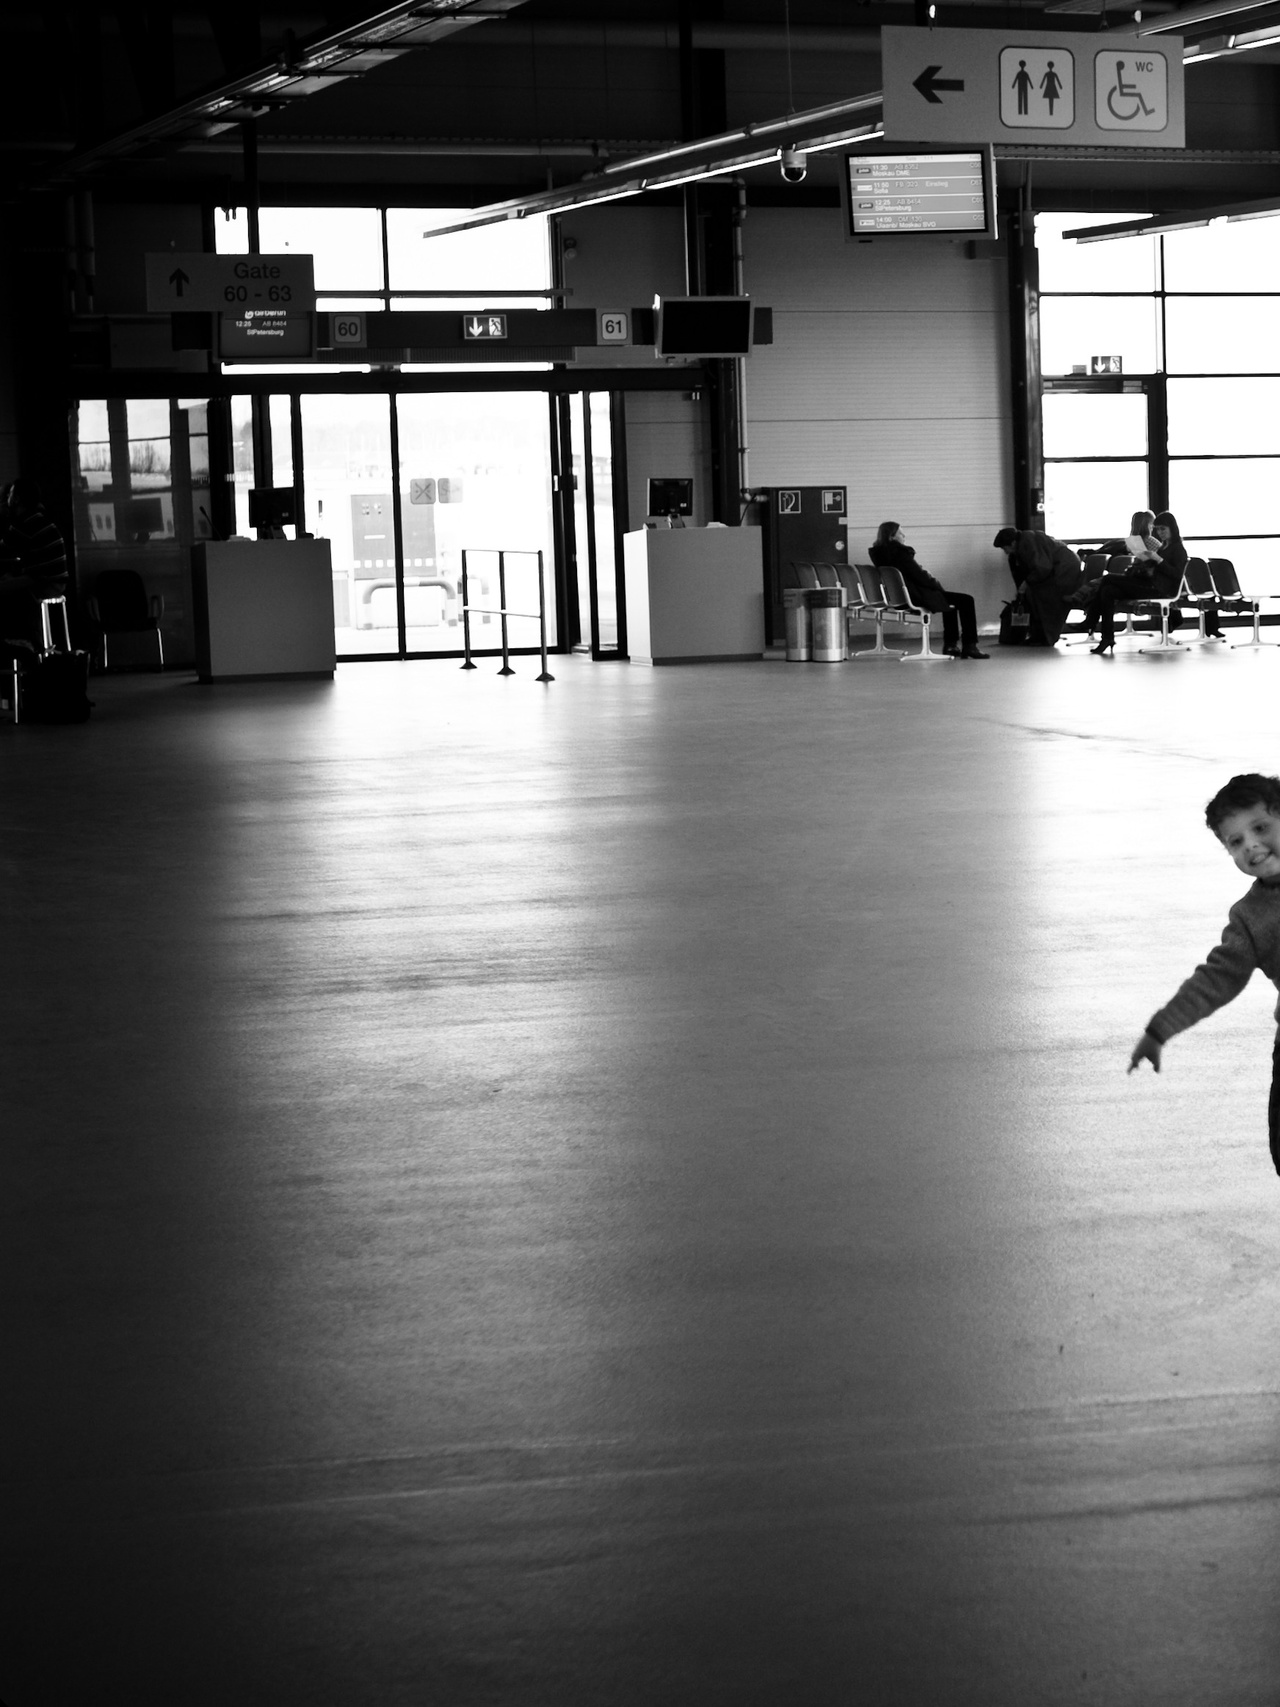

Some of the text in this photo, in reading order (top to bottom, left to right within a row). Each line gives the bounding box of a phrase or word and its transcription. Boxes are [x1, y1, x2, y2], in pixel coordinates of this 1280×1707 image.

[1135, 61, 1154, 73] WC
[234, 262, 281, 279] Gate
[224, 285, 248, 302] 60
[268, 285, 292, 302] 63
[338, 321, 358, 337] 60
[605, 320, 623, 334] 61
